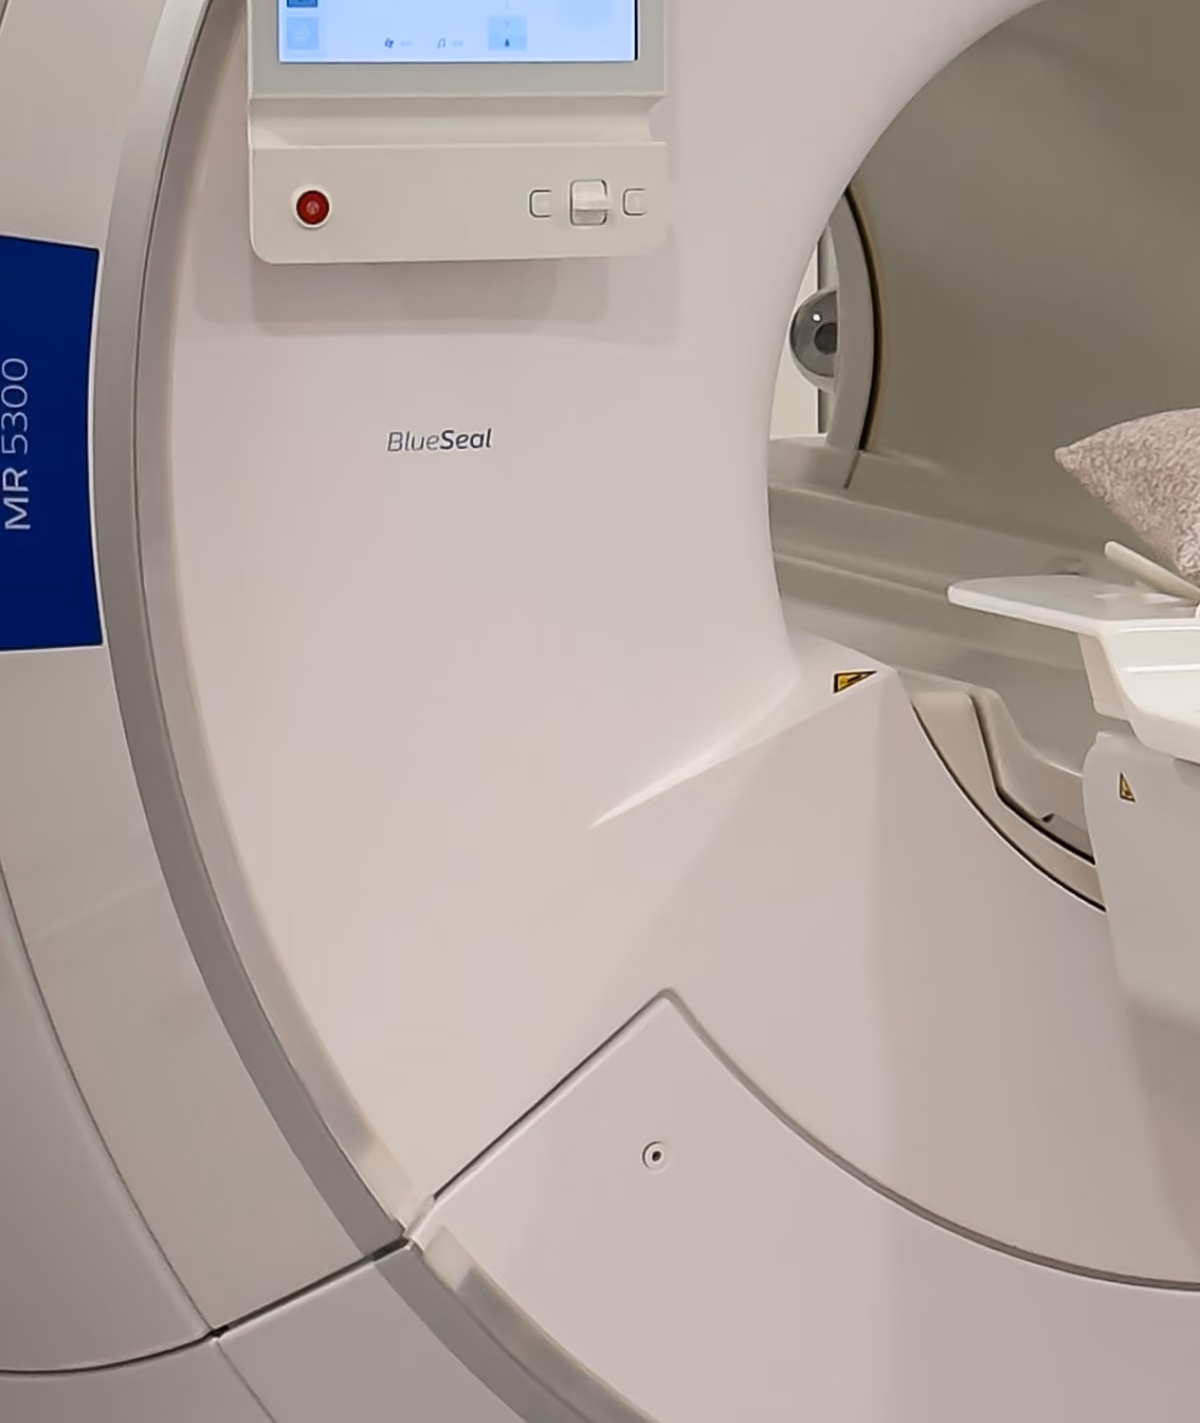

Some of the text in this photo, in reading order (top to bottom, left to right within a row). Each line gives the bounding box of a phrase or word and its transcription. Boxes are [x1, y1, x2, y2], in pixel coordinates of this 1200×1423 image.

[1, 357, 31, 530] MR 5300
[387, 428, 493, 453] BlueSeal
